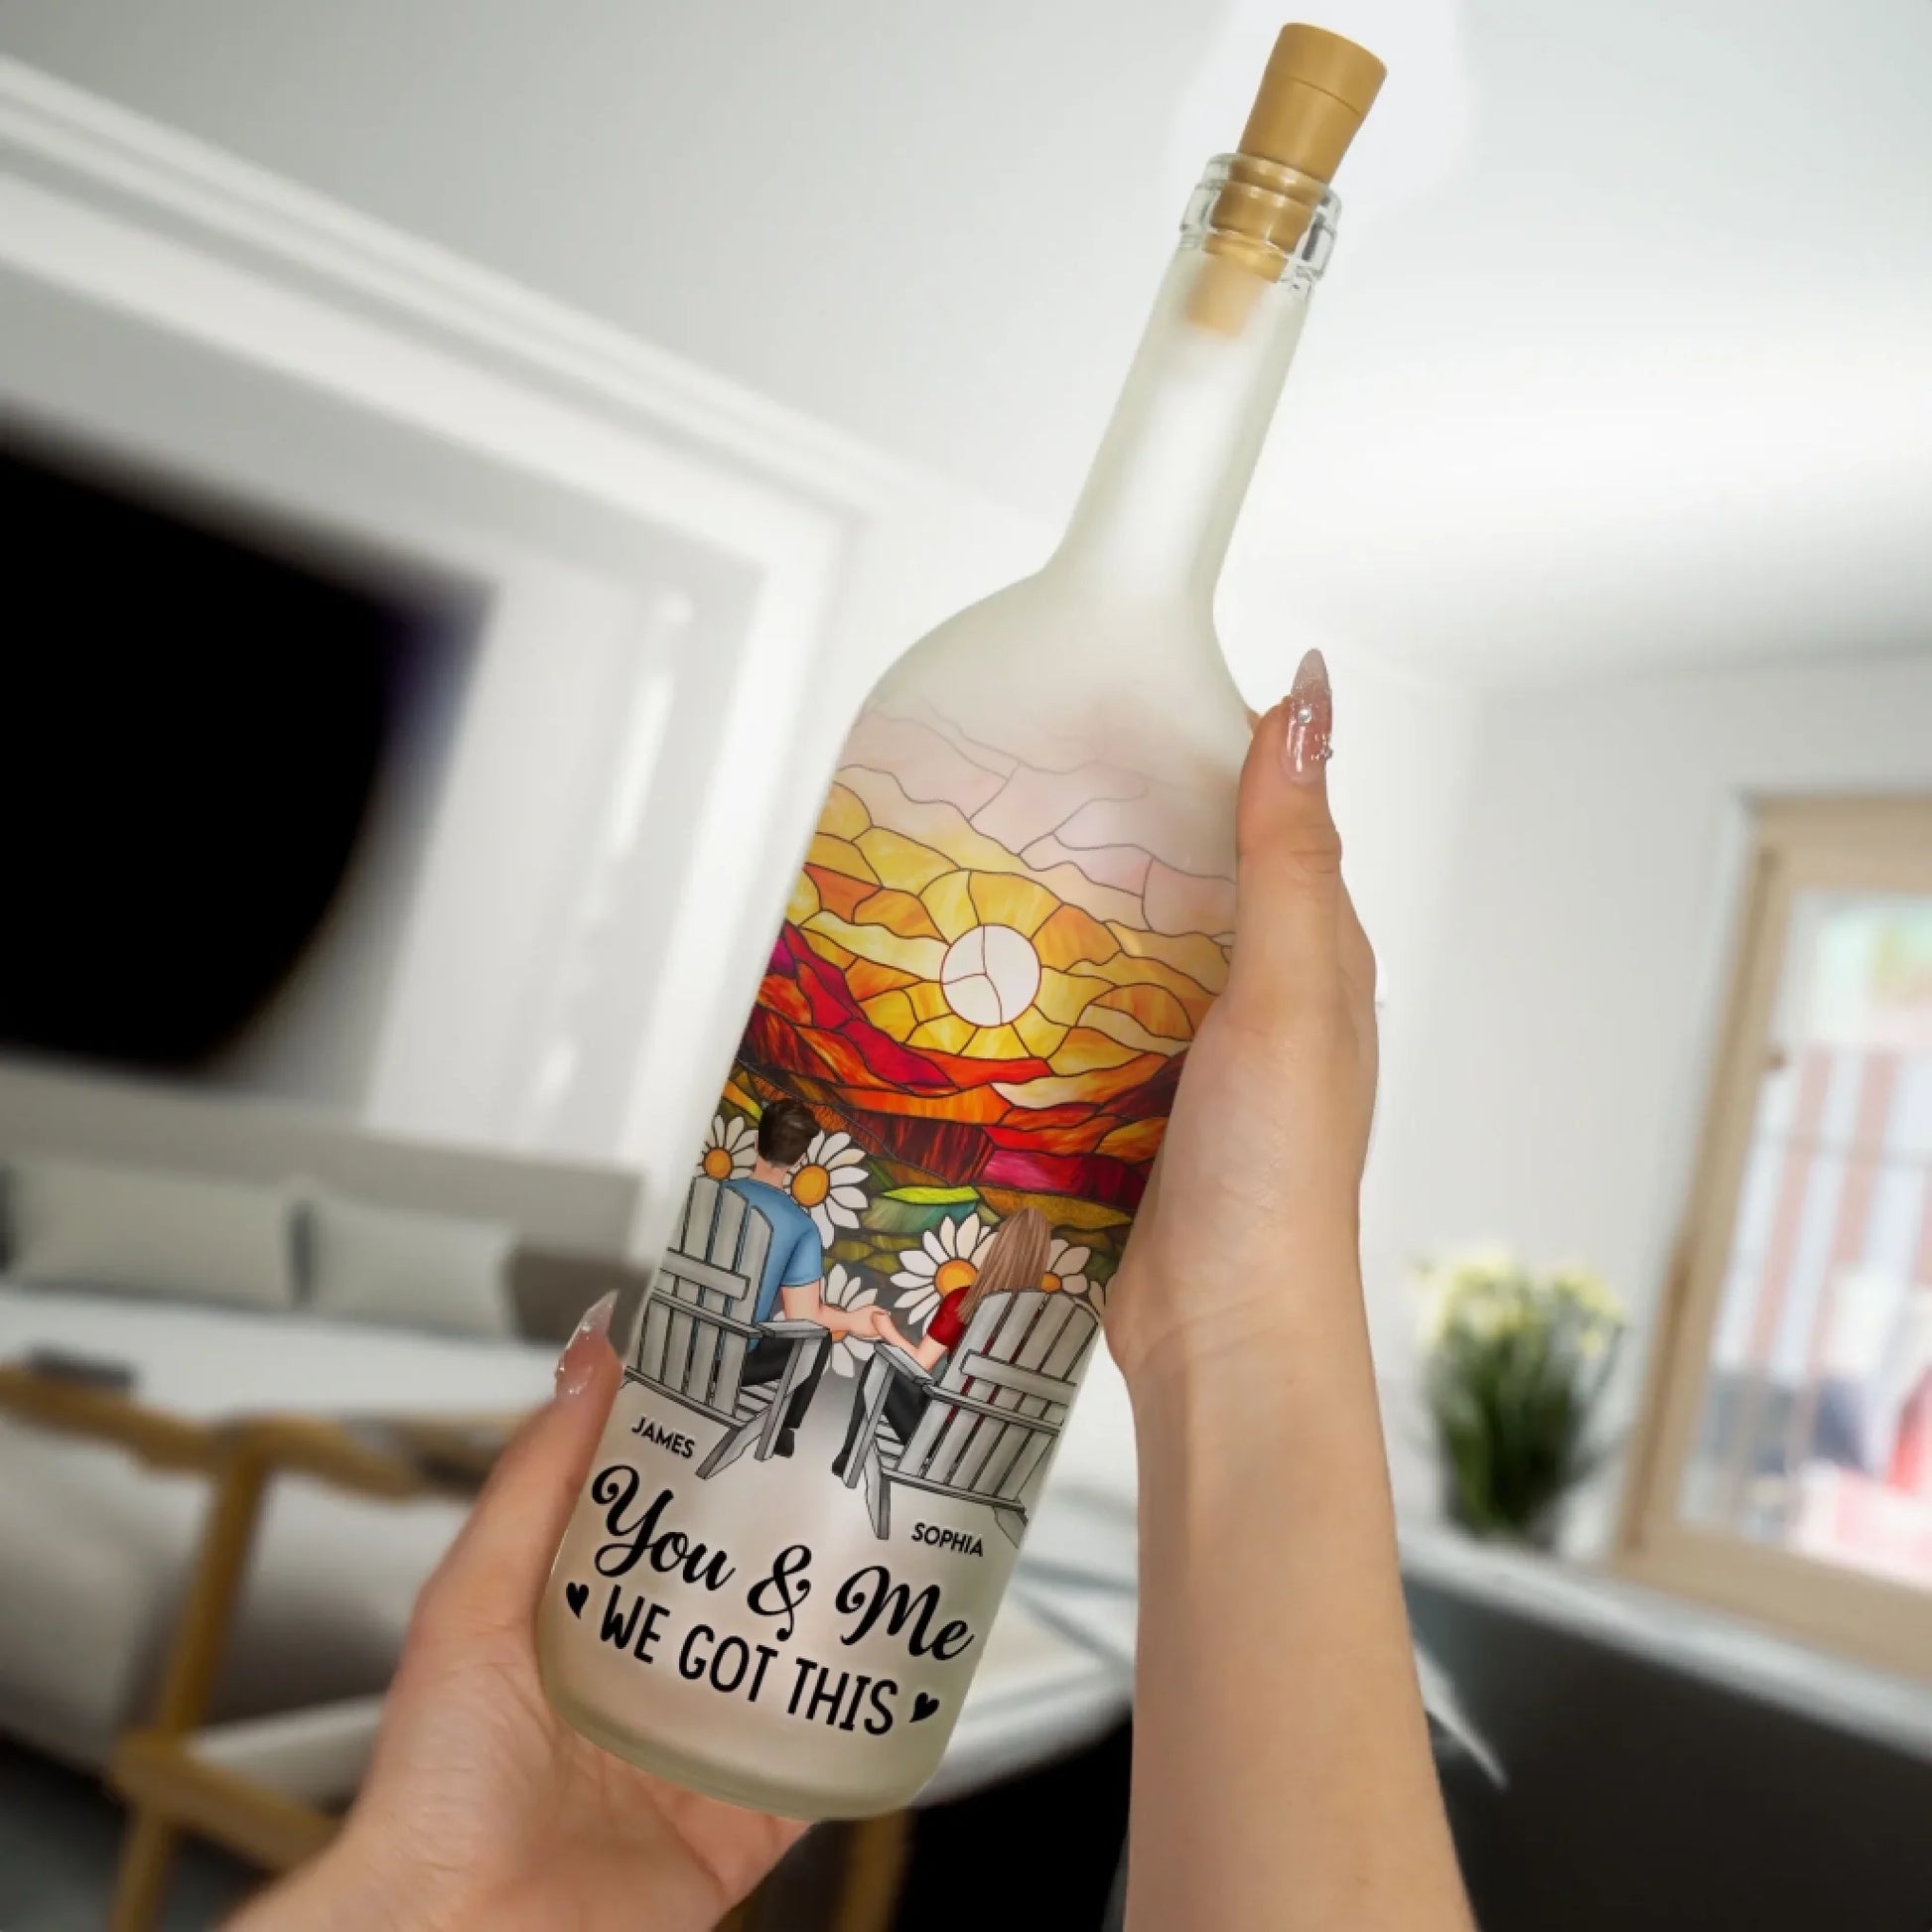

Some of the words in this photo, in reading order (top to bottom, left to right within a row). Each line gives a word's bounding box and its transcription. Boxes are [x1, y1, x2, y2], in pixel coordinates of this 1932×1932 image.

[630, 1416, 696, 1459] JAMES
[591, 1464, 737, 1591] You
[747, 1544, 812, 1642] &
[835, 1565, 975, 1662] Me
[910, 1522, 984, 1558] SOPHIA
[599, 1584, 671, 1665] WE
[678, 1623, 778, 1703] GOT
[787, 1657, 899, 1736] THIS
